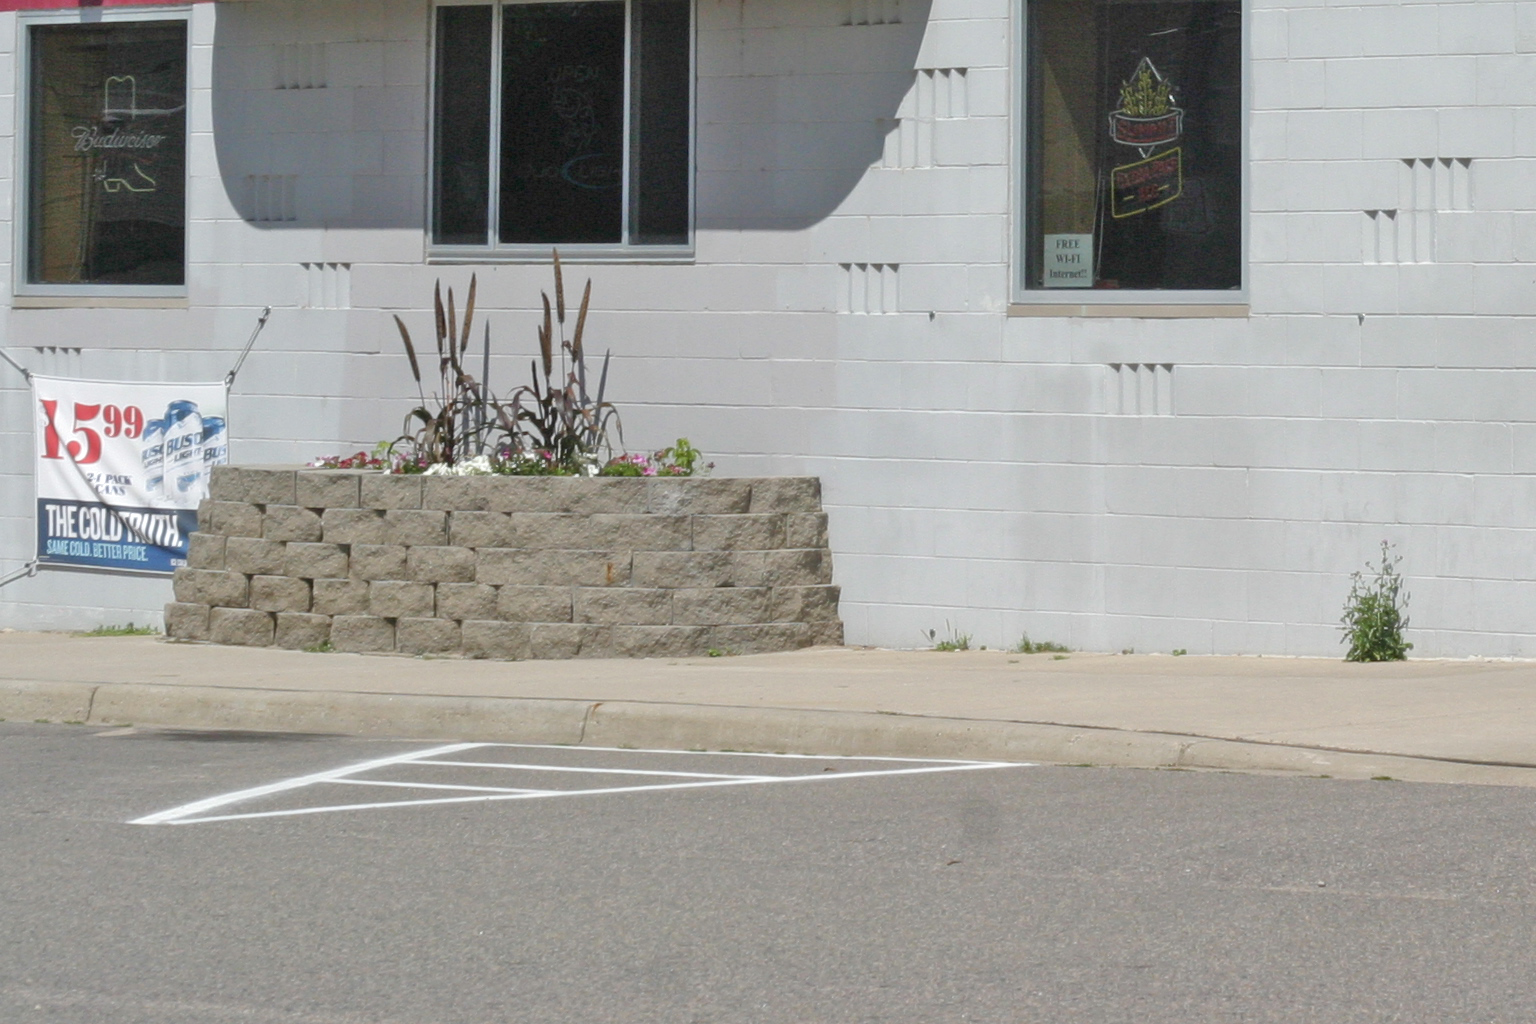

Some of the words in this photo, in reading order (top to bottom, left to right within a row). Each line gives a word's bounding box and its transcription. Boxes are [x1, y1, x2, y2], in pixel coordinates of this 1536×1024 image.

[70, 125, 167, 152] Budweiser
[1056, 239, 1080, 249] FREE
[1056, 254, 1081, 263] WI-FI
[105, 473, 134, 486] PACK
[95, 484, 126, 496] CANS
[45, 504, 77, 538] THE
[78, 506, 123, 542] COLD
[47, 540, 69, 555] SAME
[69, 541, 92, 557] COLD.
[93, 542, 123, 559] BETTER
[123, 545, 149, 562] PRICE.
